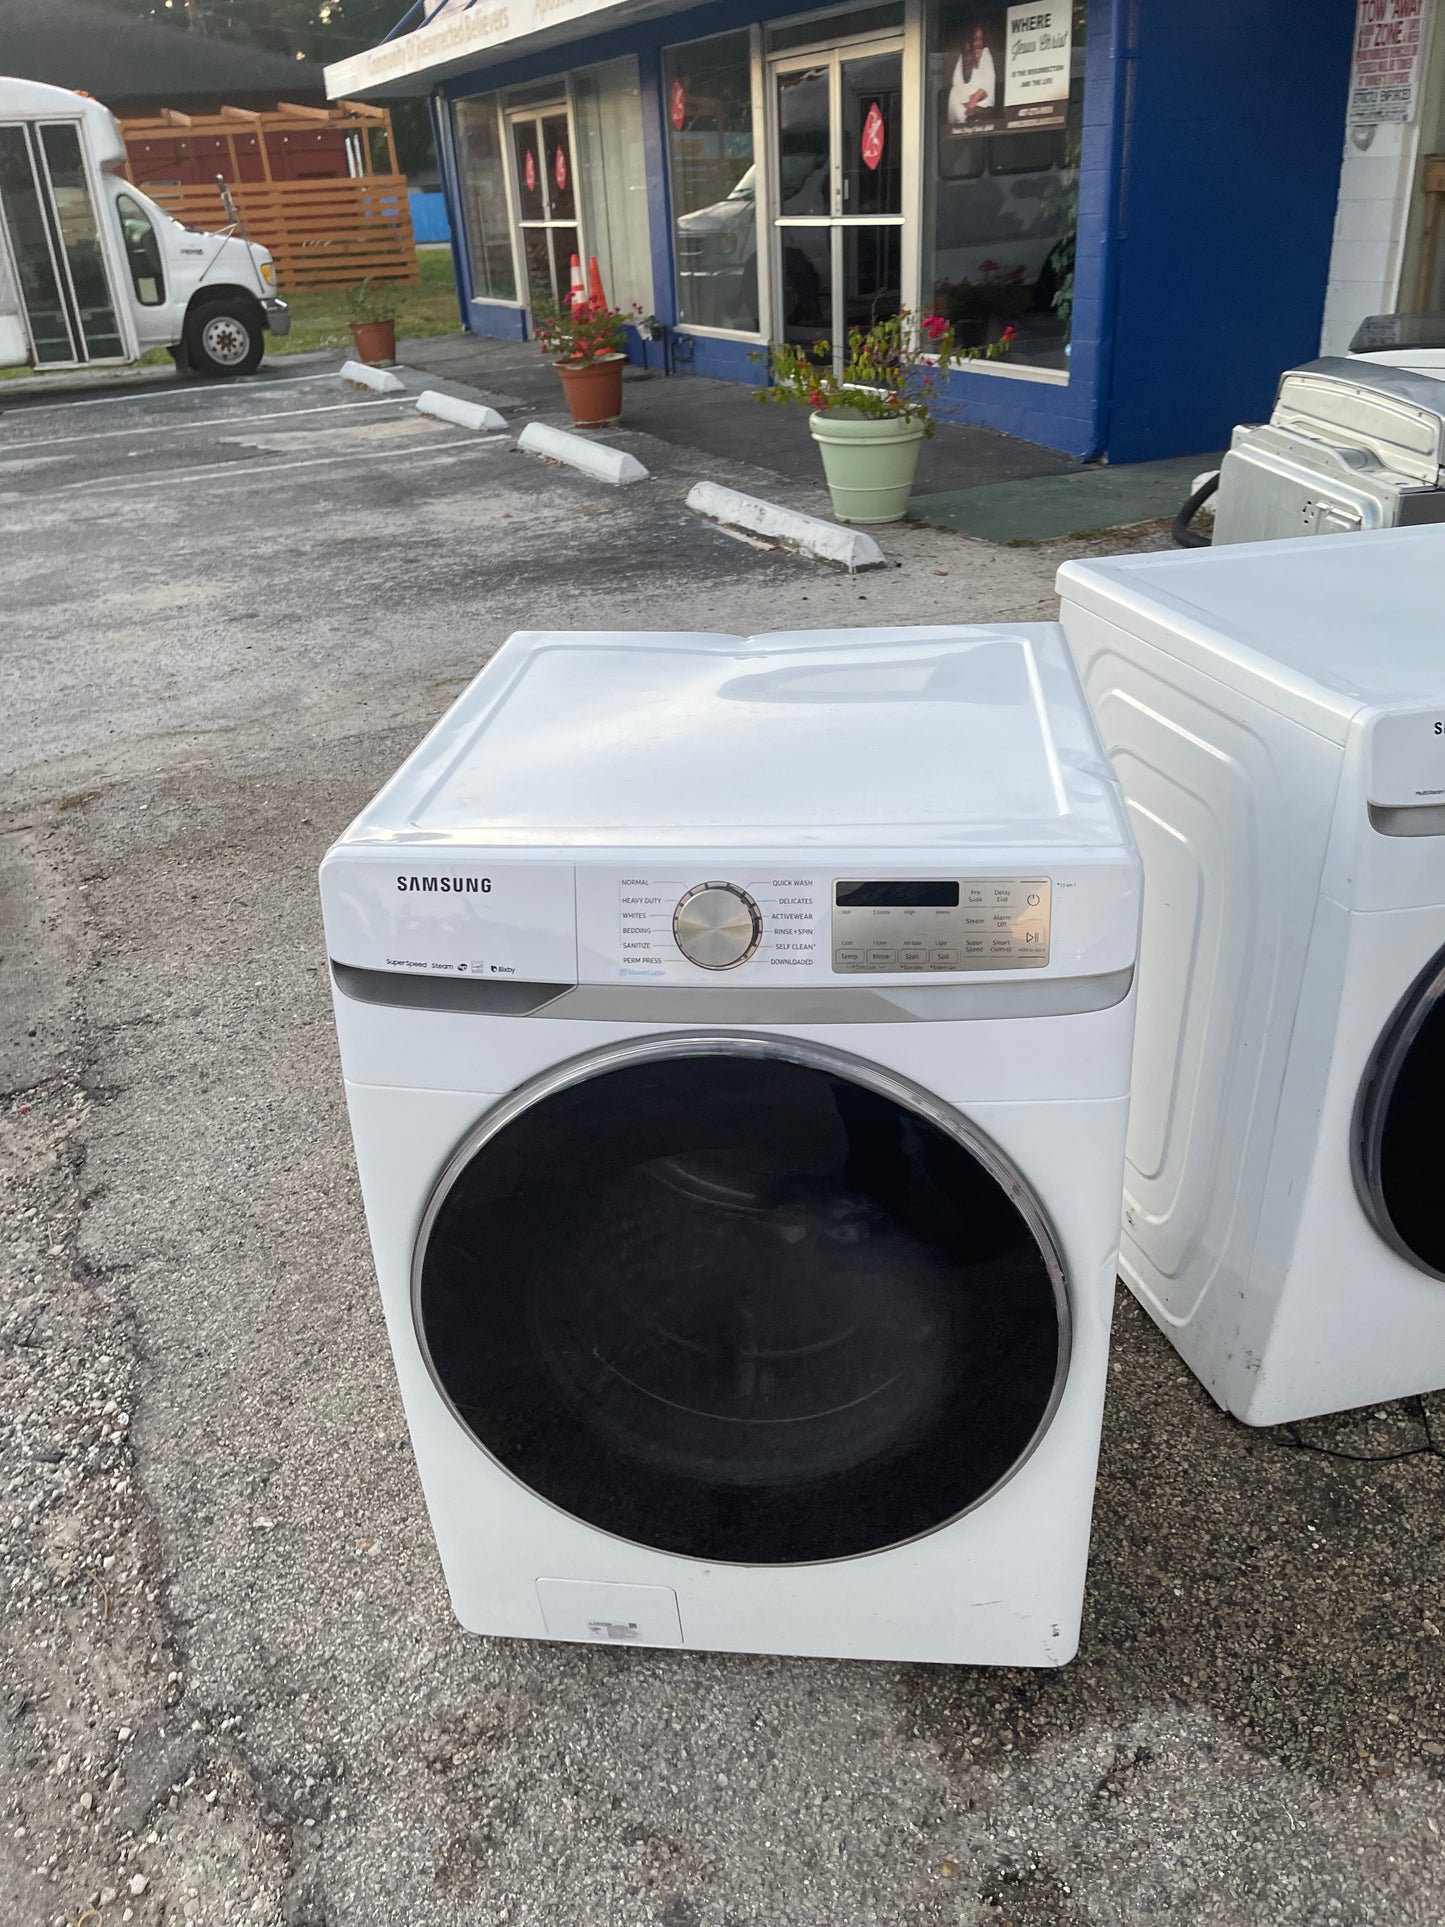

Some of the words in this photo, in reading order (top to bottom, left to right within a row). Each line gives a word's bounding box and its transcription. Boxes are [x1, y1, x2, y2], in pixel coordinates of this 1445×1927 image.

[1011, 13, 1051, 33] WHERE
[1374, 21, 1402, 46] ZONE
[397, 876, 492, 893] SAMSUNG
[431, 962, 454, 970] Steam
